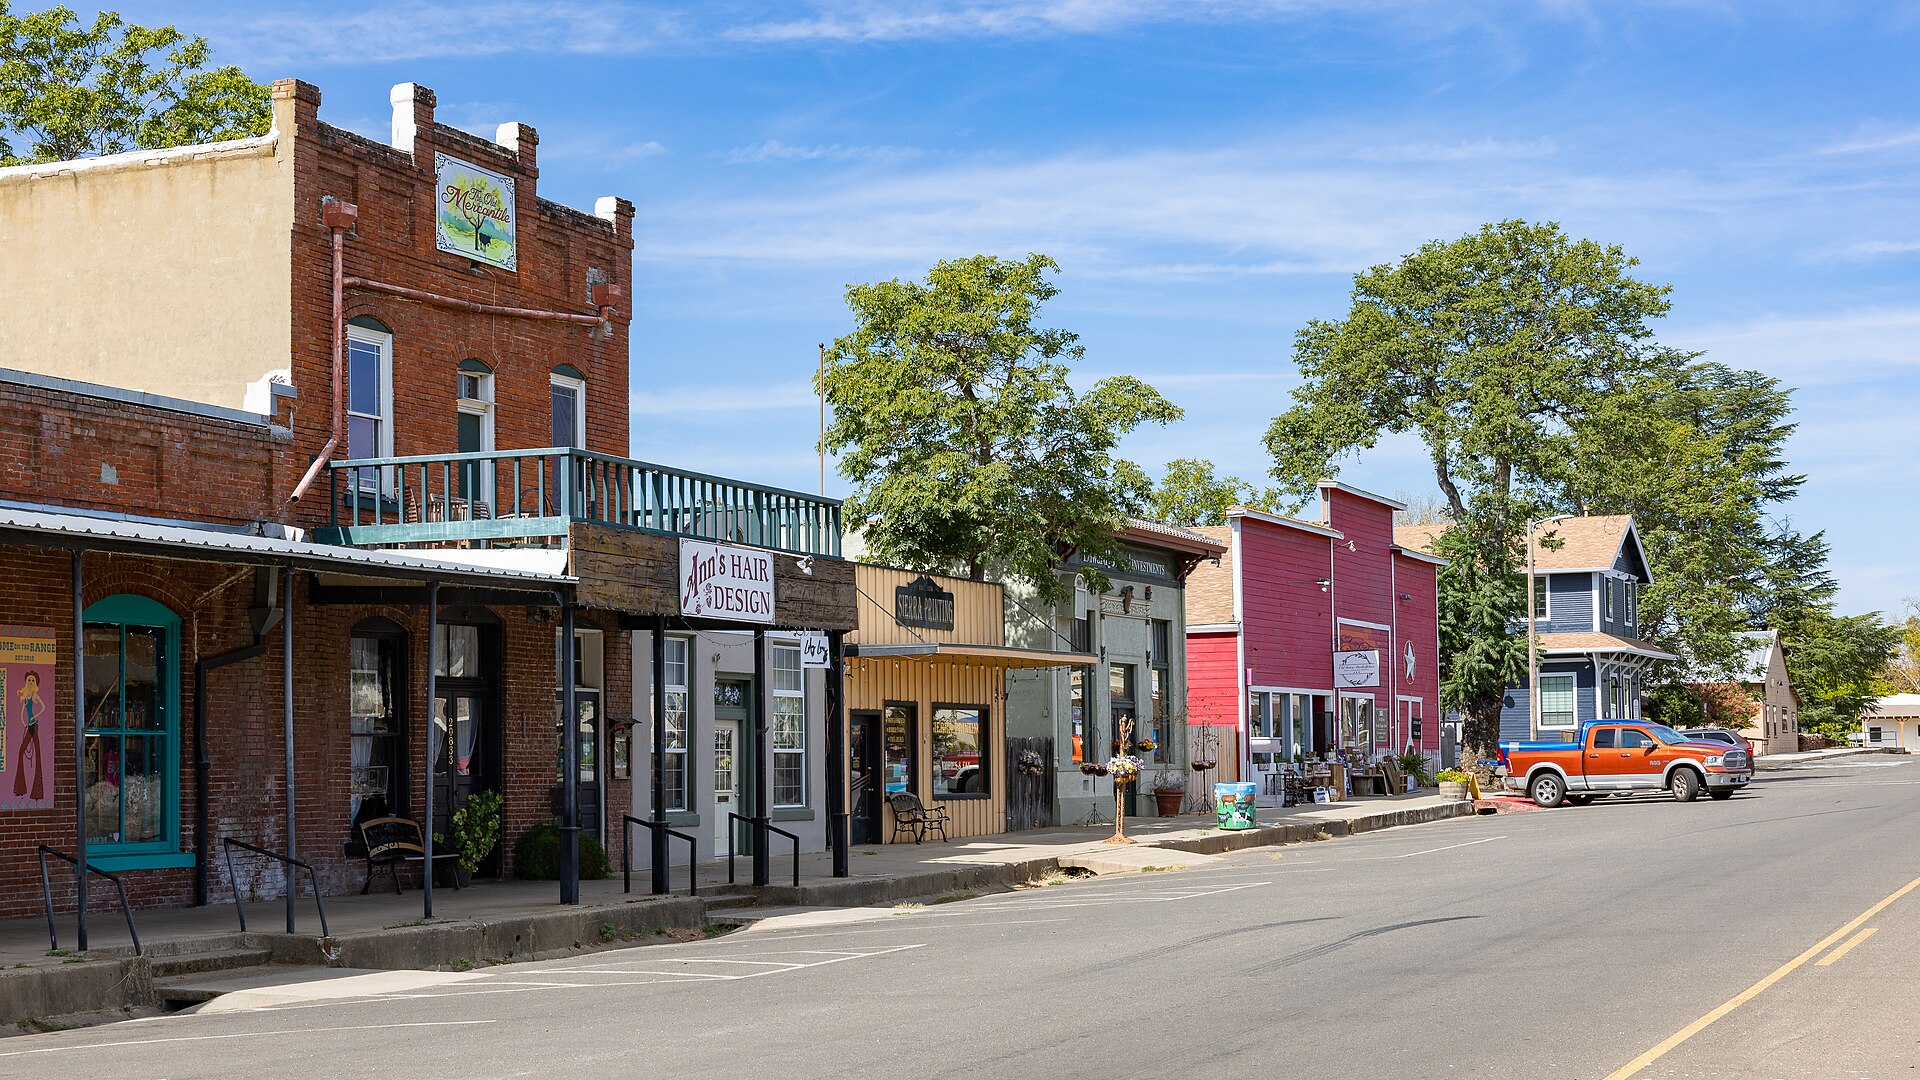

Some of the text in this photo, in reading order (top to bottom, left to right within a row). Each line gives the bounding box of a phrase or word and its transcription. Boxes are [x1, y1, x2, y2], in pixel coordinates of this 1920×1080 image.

[441, 185, 511, 223] Mercantile
[469, 187, 497, 207] The Old
[682, 546, 769, 610] Ann's HAIR
[713, 586, 770, 614] DESIGN
[898, 594, 954, 624] SIERRA PRINTING
[30, 642, 56, 653] RANGE
